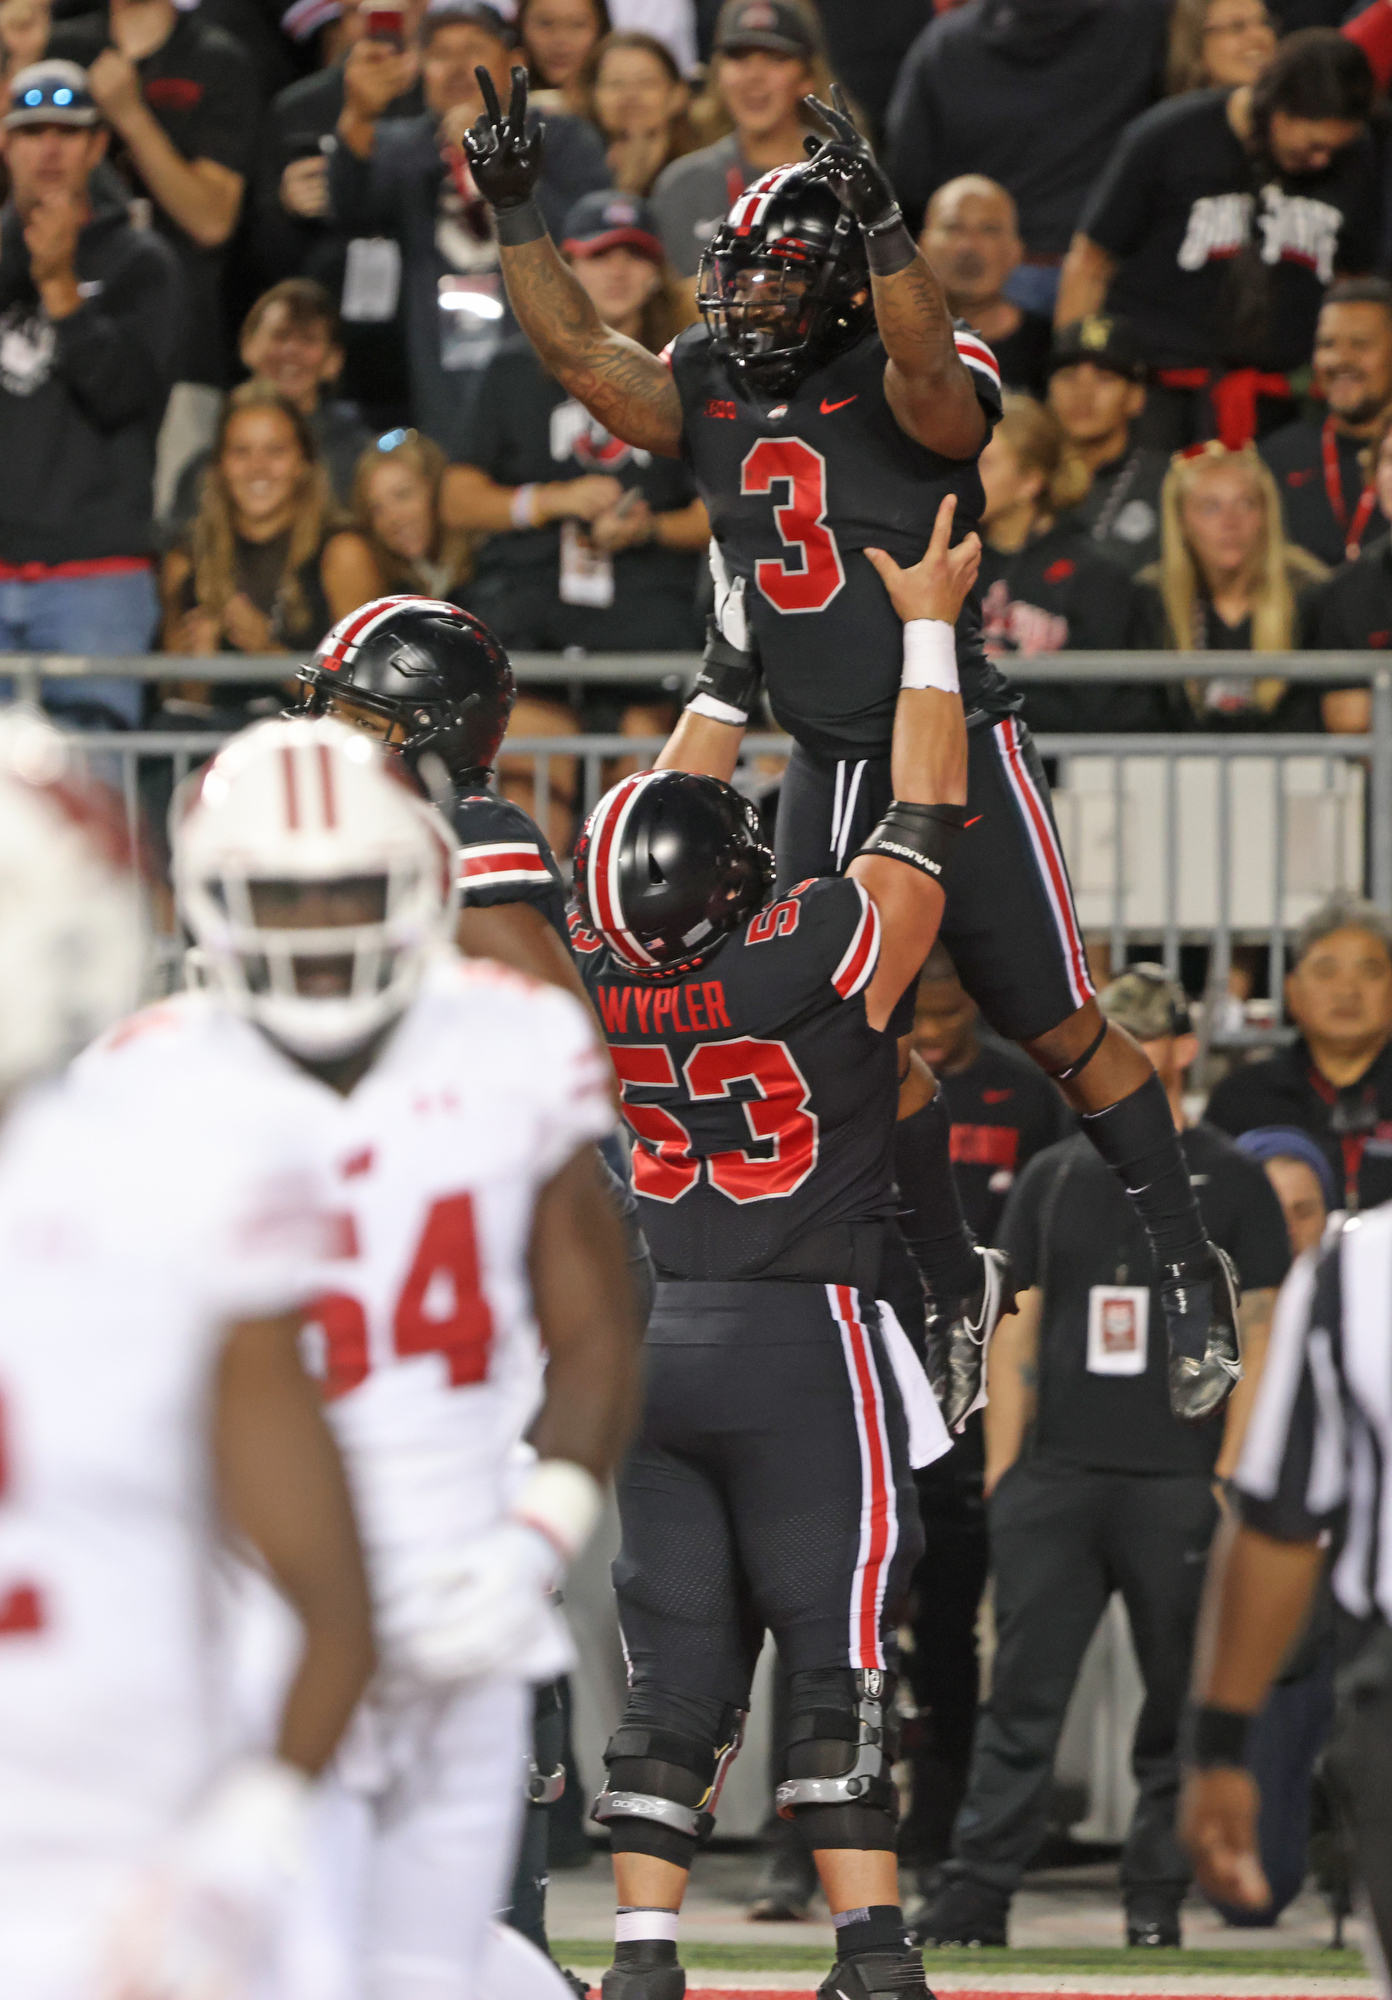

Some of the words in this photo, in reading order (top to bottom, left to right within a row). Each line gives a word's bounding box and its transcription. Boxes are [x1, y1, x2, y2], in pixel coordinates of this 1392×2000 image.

[740, 436, 846, 614] 3
[598, 980, 731, 1034] WYPLER
[607, 1035, 819, 1205] 53
